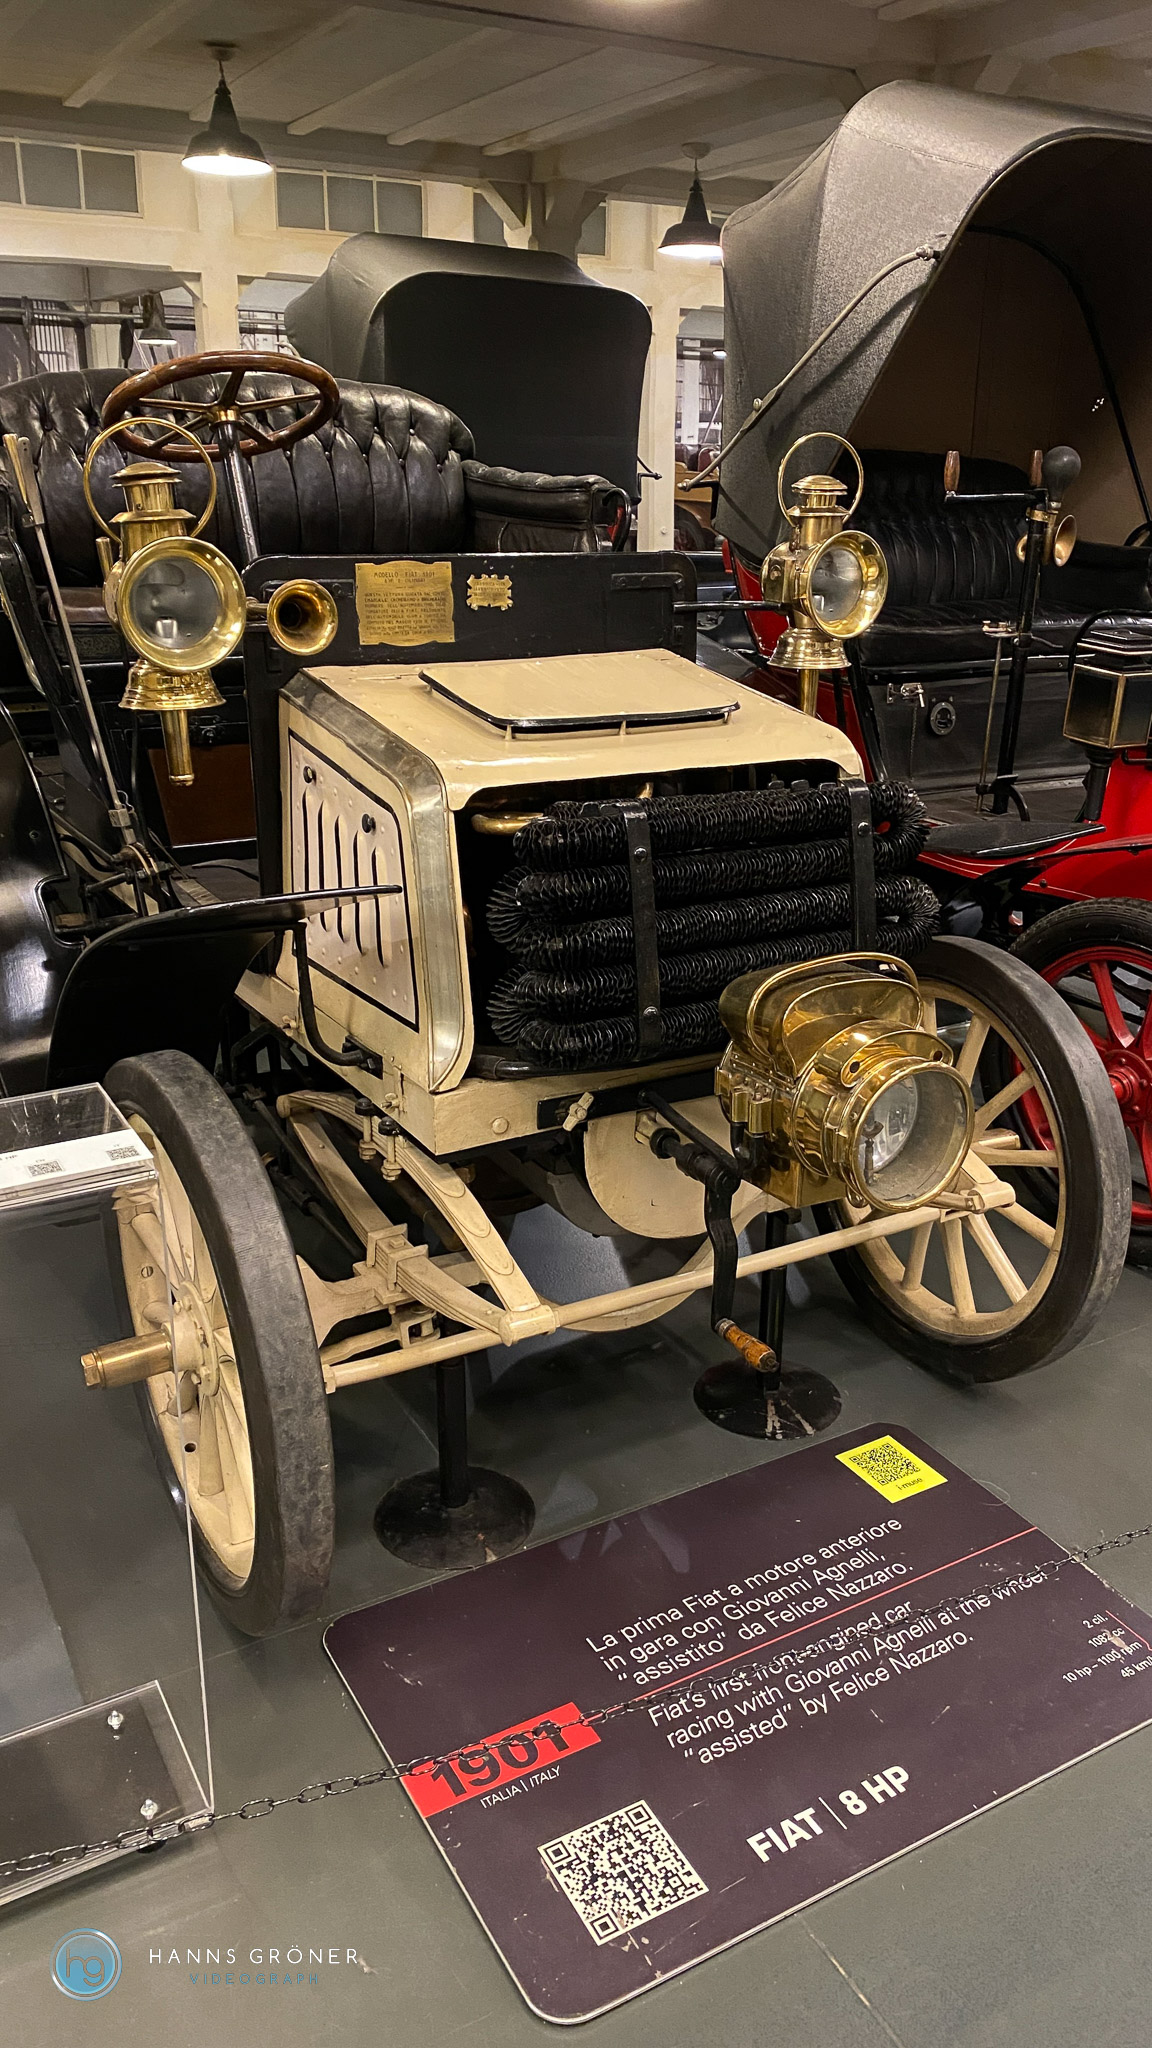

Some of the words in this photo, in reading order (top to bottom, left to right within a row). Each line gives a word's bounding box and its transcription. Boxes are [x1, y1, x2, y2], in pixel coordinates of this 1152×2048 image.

[586, 1634, 618, 1652] La
[620, 1608, 684, 1643] prima
[682, 1589, 727, 1613] Fiat
[727, 1584, 743, 1596] a
[744, 1554, 817, 1589] motore
[819, 1519, 902, 1559] anteriore
[600, 1653, 627, 1672] in
[630, 1634, 679, 1663] gara
[681, 1616, 722, 1639] con
[722, 1576, 812, 1620] Giovanni
[812, 1548, 886, 1586] Agnelli,
[738, 1621, 767, 1640] da
[764, 1596, 828, 1628] Felice
[826, 1563, 913, 1601] Nazzaro.
[1082, 1620, 1094, 1629] 2
[1092, 1613, 1108, 1625] cil.
[648, 1692, 706, 1727] Fiat's
[884, 1601, 912, 1622] car
[666, 1708, 735, 1748] racing
[734, 1685, 784, 1716] with
[785, 1643, 872, 1693] Giovanni
[873, 1615, 937, 1656] Agnelli
[937, 1606, 960, 1626] at
[959, 1594, 991, 1616] the
[799, 1693, 828, 1716] by
[828, 1667, 890, 1702] Felice
[888, 1631, 974, 1675] Nazzaro.
[1062, 1672, 1078, 1683] 10
[1074, 1666, 1092, 1678] hp
[1097, 1649, 1121, 1666] 1100
[1120, 1641, 1143, 1656] rpm
[1088, 1632, 1112, 1648] 1082
[1112, 1627, 1125, 1637] cc
[1121, 1666, 1135, 1678] 45
[431, 1720, 569, 1797] 1901
[480, 1785, 522, 1809] ITALIA
[530, 1765, 561, 1788] ITALY
[746, 1807, 823, 1862] FIAT
[838, 1790, 868, 1815] 8
[861, 1765, 909, 1804] HP
